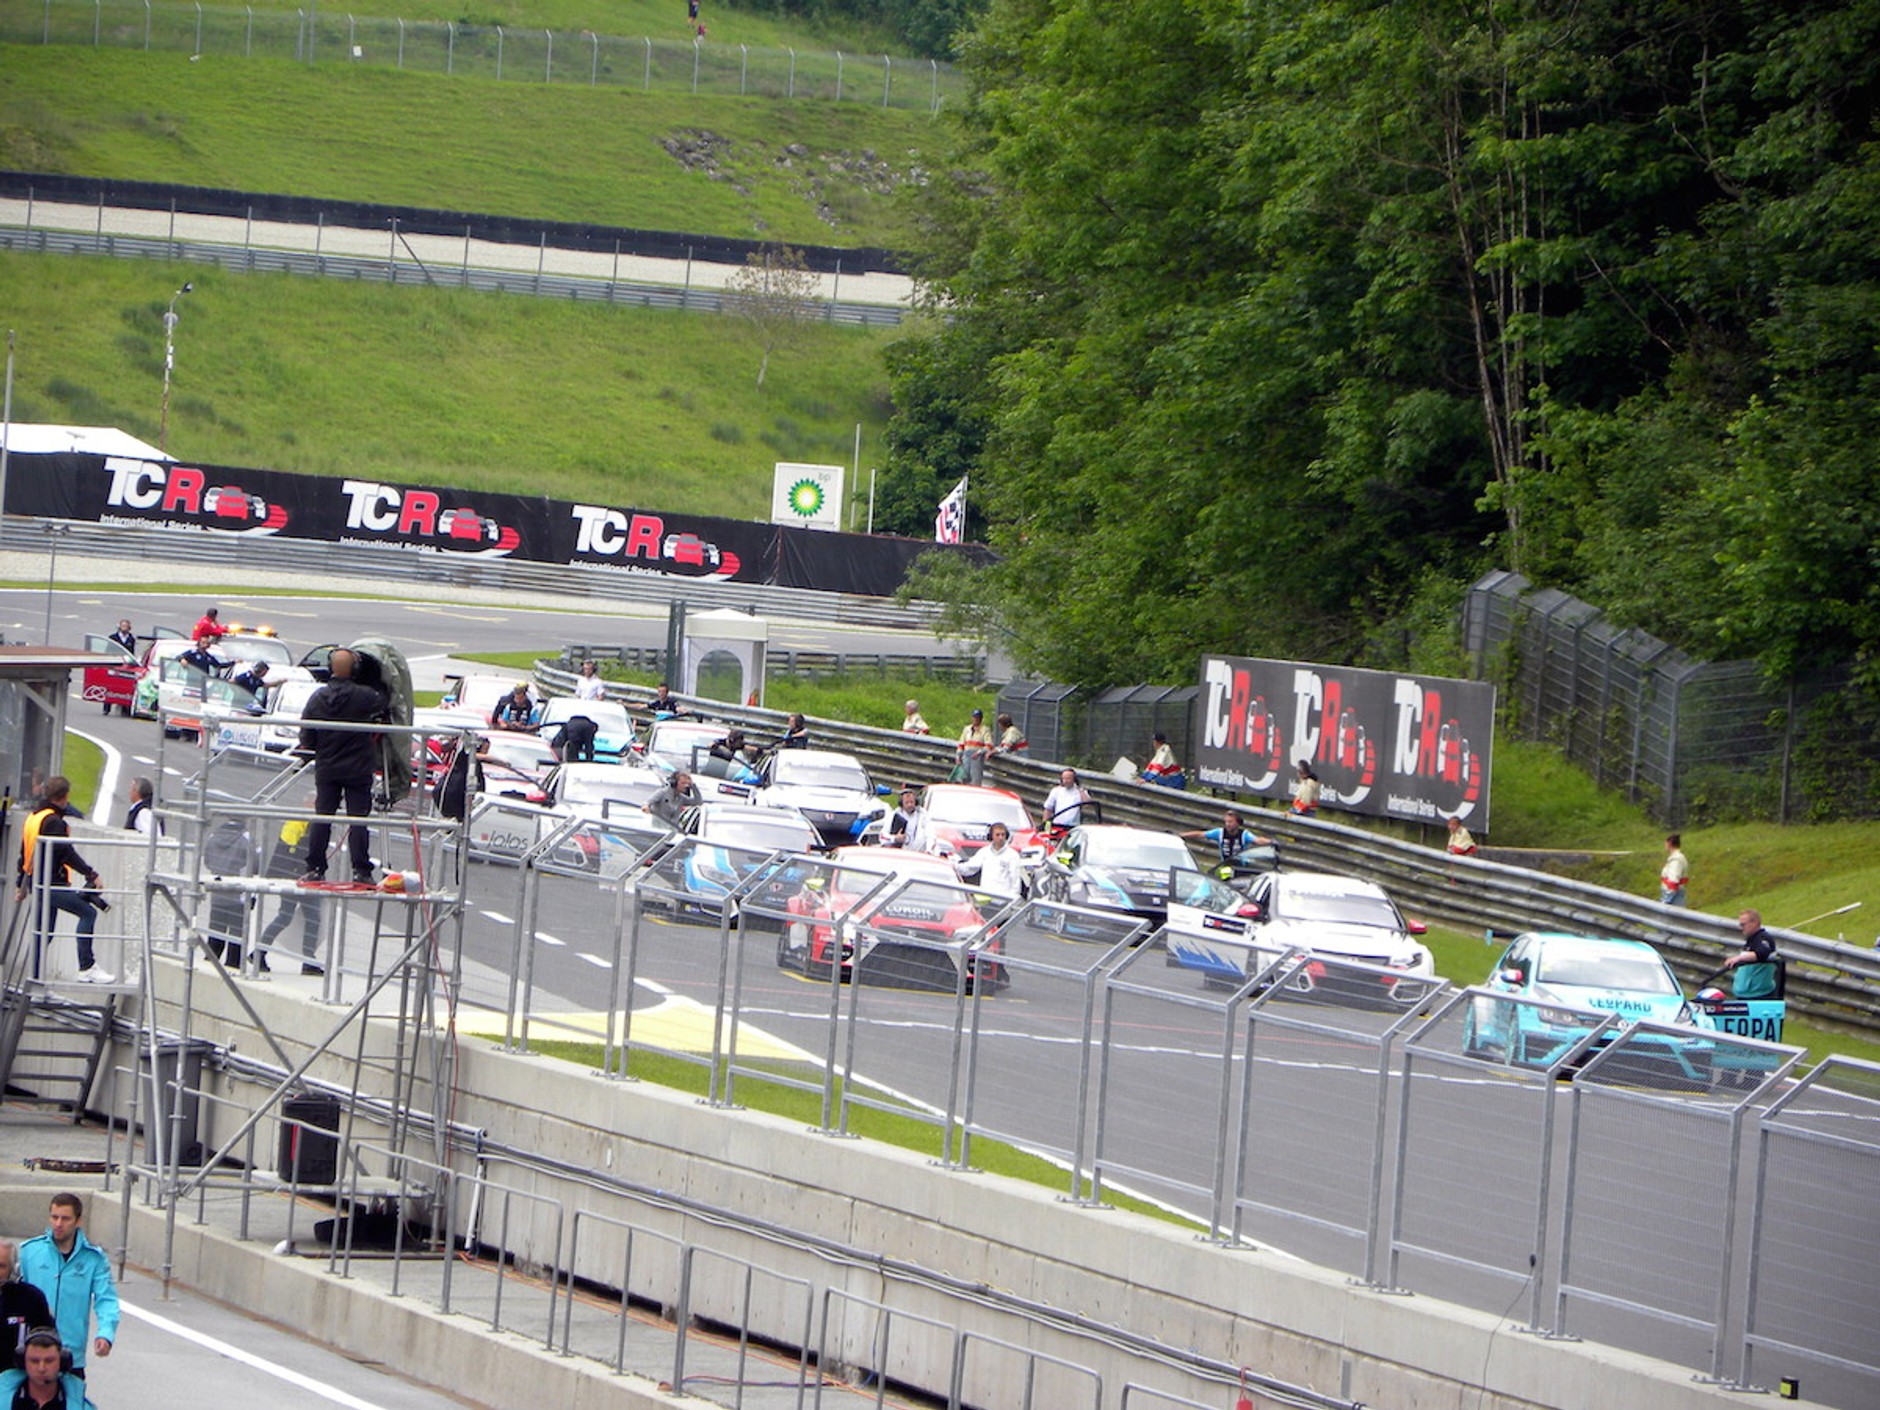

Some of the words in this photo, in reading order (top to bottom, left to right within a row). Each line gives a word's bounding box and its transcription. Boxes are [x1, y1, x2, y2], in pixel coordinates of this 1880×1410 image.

[104, 457, 205, 514] TCR
[342, 480, 440, 536] TCR
[572, 505, 664, 560] TCR
[1204, 659, 1251, 750] TCR
[1292, 669, 1342, 765] TCR
[1394, 678, 1441, 777] TCR
[885, 905, 934, 917] LUKOIL
[1588, 997, 1652, 1013] LEOPARD
